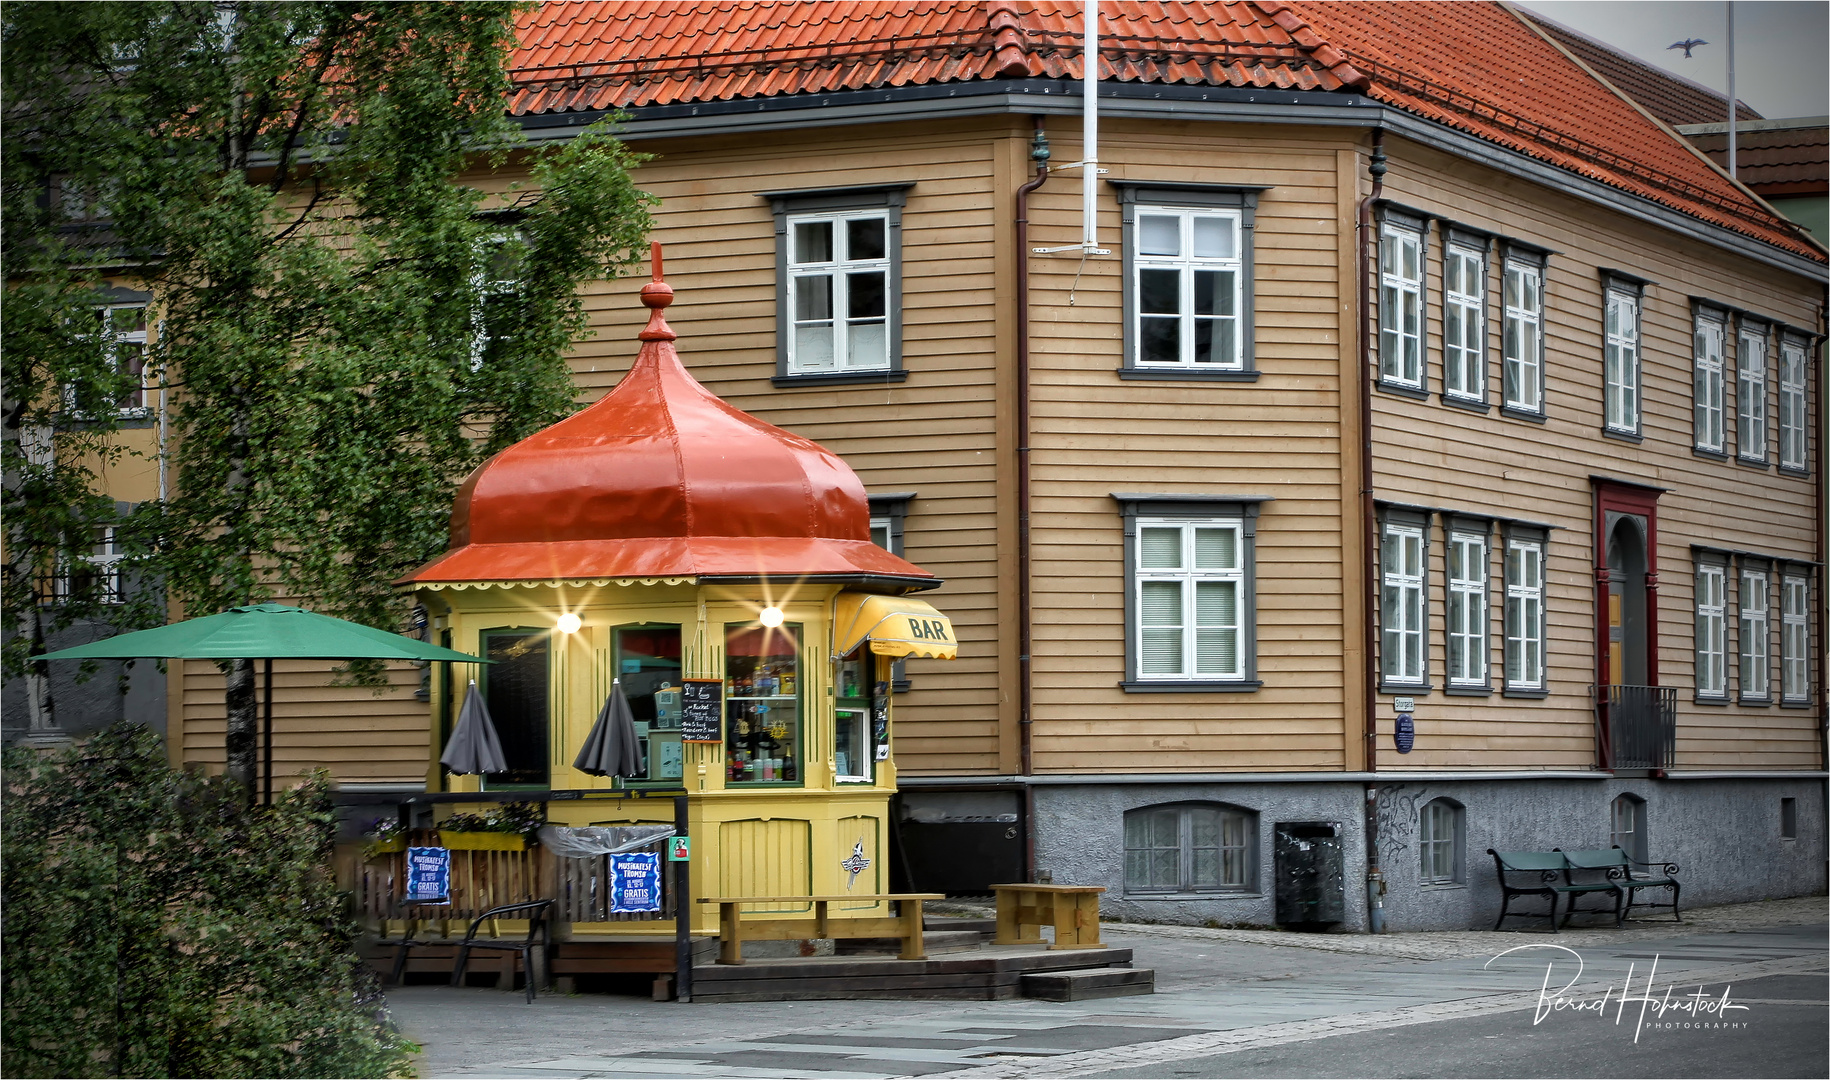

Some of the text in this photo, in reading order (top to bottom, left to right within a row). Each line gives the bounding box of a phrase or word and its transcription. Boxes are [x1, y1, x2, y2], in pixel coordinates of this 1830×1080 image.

[908, 618, 948, 640] BAR
[417, 882, 440, 891] GRATIS
[623, 889, 649, 898] GRATIS
